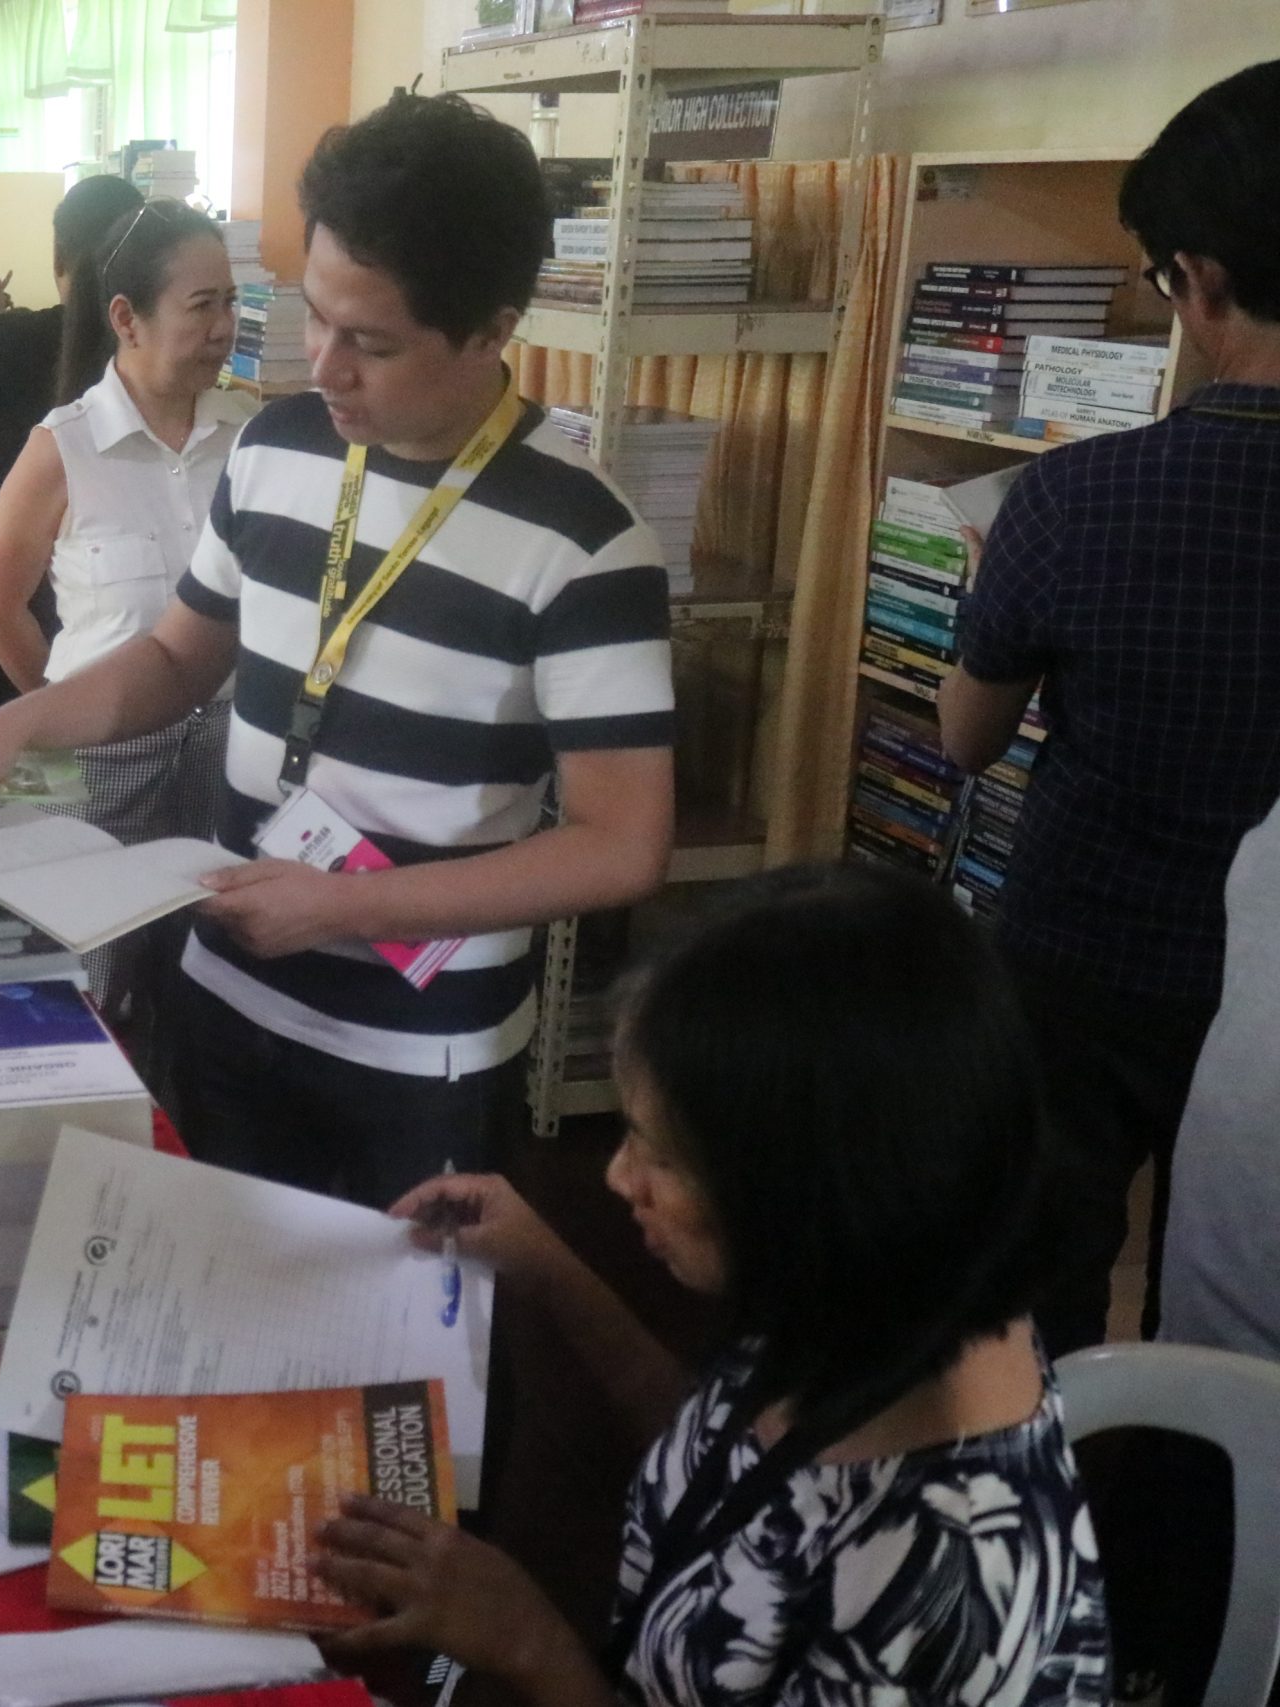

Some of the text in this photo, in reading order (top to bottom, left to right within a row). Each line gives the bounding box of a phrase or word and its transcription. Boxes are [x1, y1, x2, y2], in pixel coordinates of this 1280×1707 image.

[708, 89, 774, 130] COLLECTION
[1034, 363, 1083, 375] PATHOLOGY
[1051, 345, 1124, 360] MEDICAL PHYSIOLOGY
[1047, 384, 1097, 397] BIOTECHNOLOGY
[1055, 376, 1091, 387] MOLECULAR
[1070, 414, 1096, 425] HUMAN
[1097, 417, 1132, 429] ANATOMY
[328, 523, 346, 565] truth
[98, 1415, 176, 1521] LET
[175, 1415, 198, 1524] COMPREHENSIVE
[373, 1405, 403, 1503] ESSIONAL
[200, 1459, 220, 1526] REVIEWER
[95, 1533, 127, 1586] LORI
[124, 1536, 156, 1590] MAR
